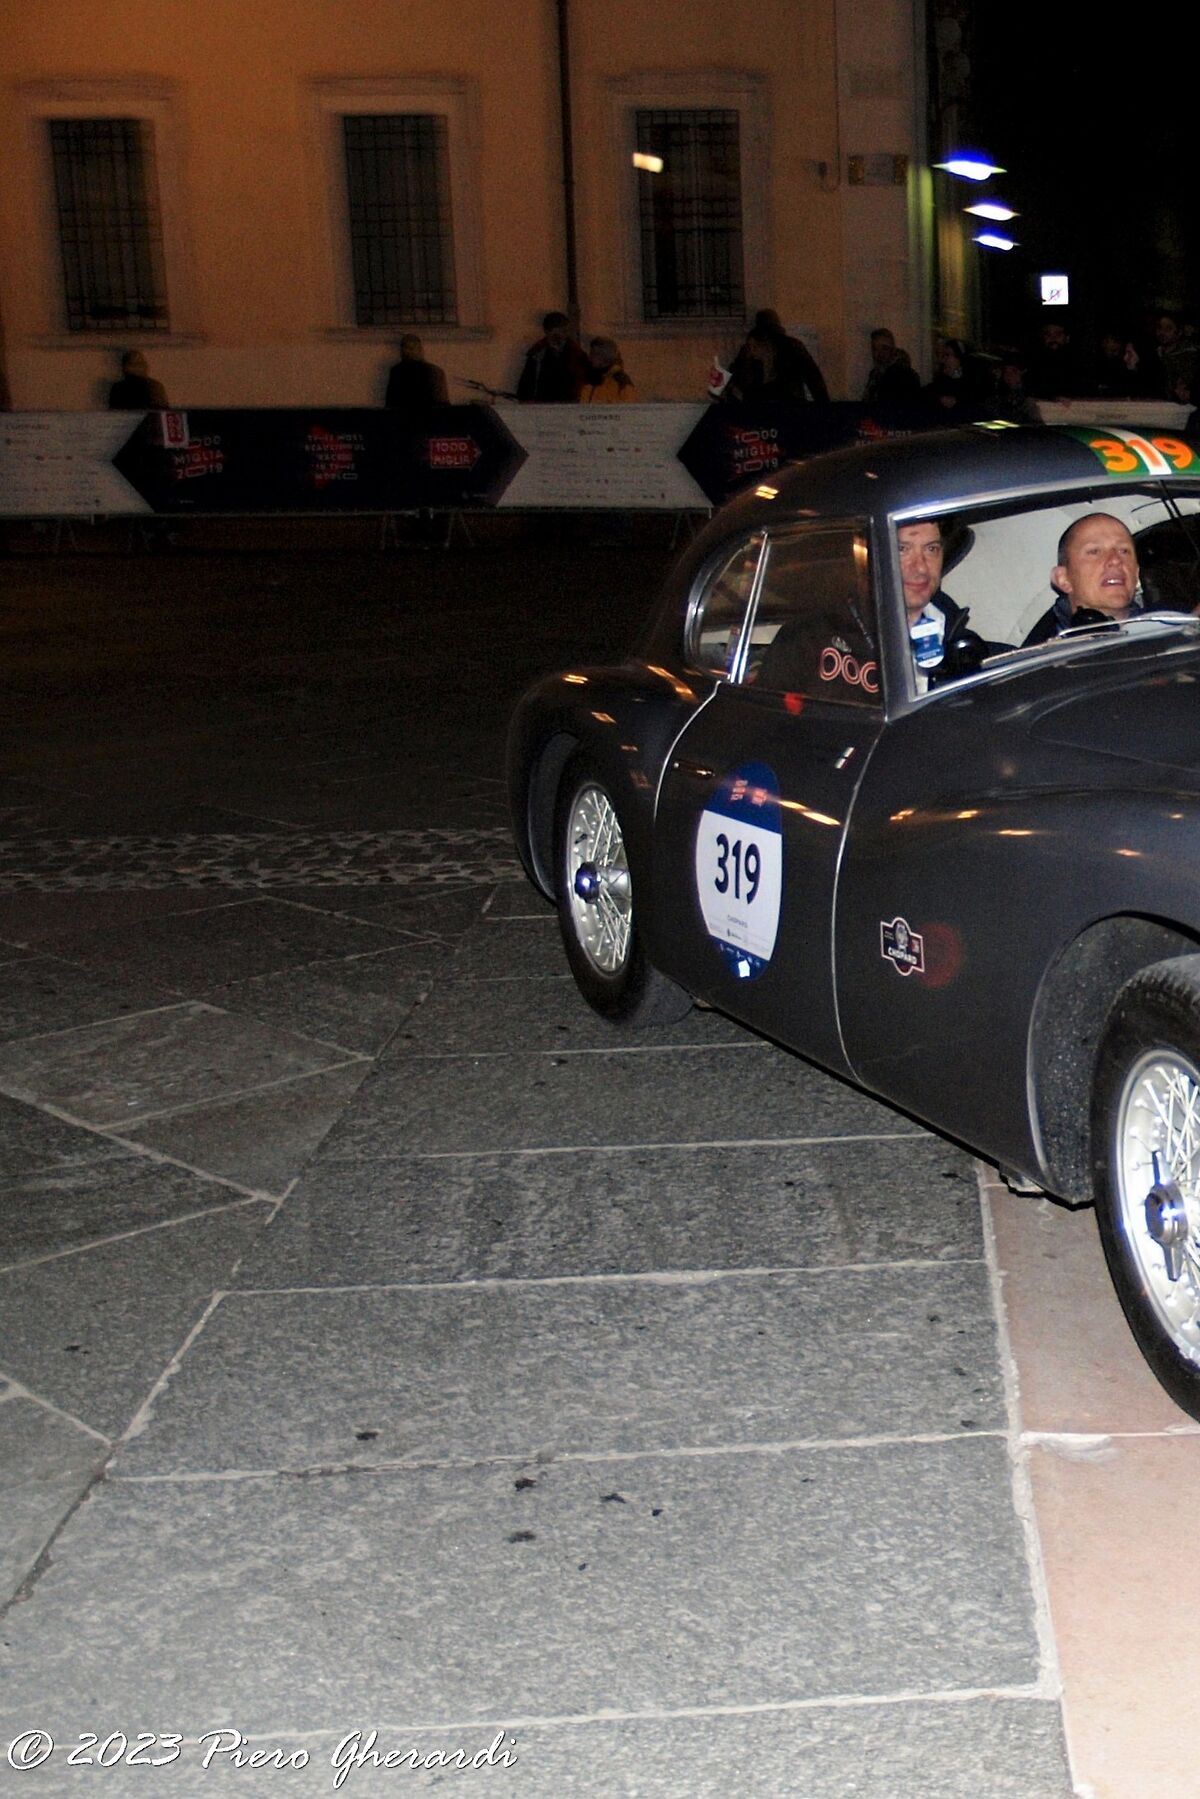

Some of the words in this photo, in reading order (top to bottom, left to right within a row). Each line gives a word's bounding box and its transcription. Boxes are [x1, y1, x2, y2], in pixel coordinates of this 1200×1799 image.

[735, 428, 778, 443] 1000
[434, 442, 469, 452] 1000
[733, 443, 779, 460] MIGLIA
[1089, 436, 1194, 473] 319
[735, 458, 778, 475] 2019
[714, 833, 762, 905] 319
